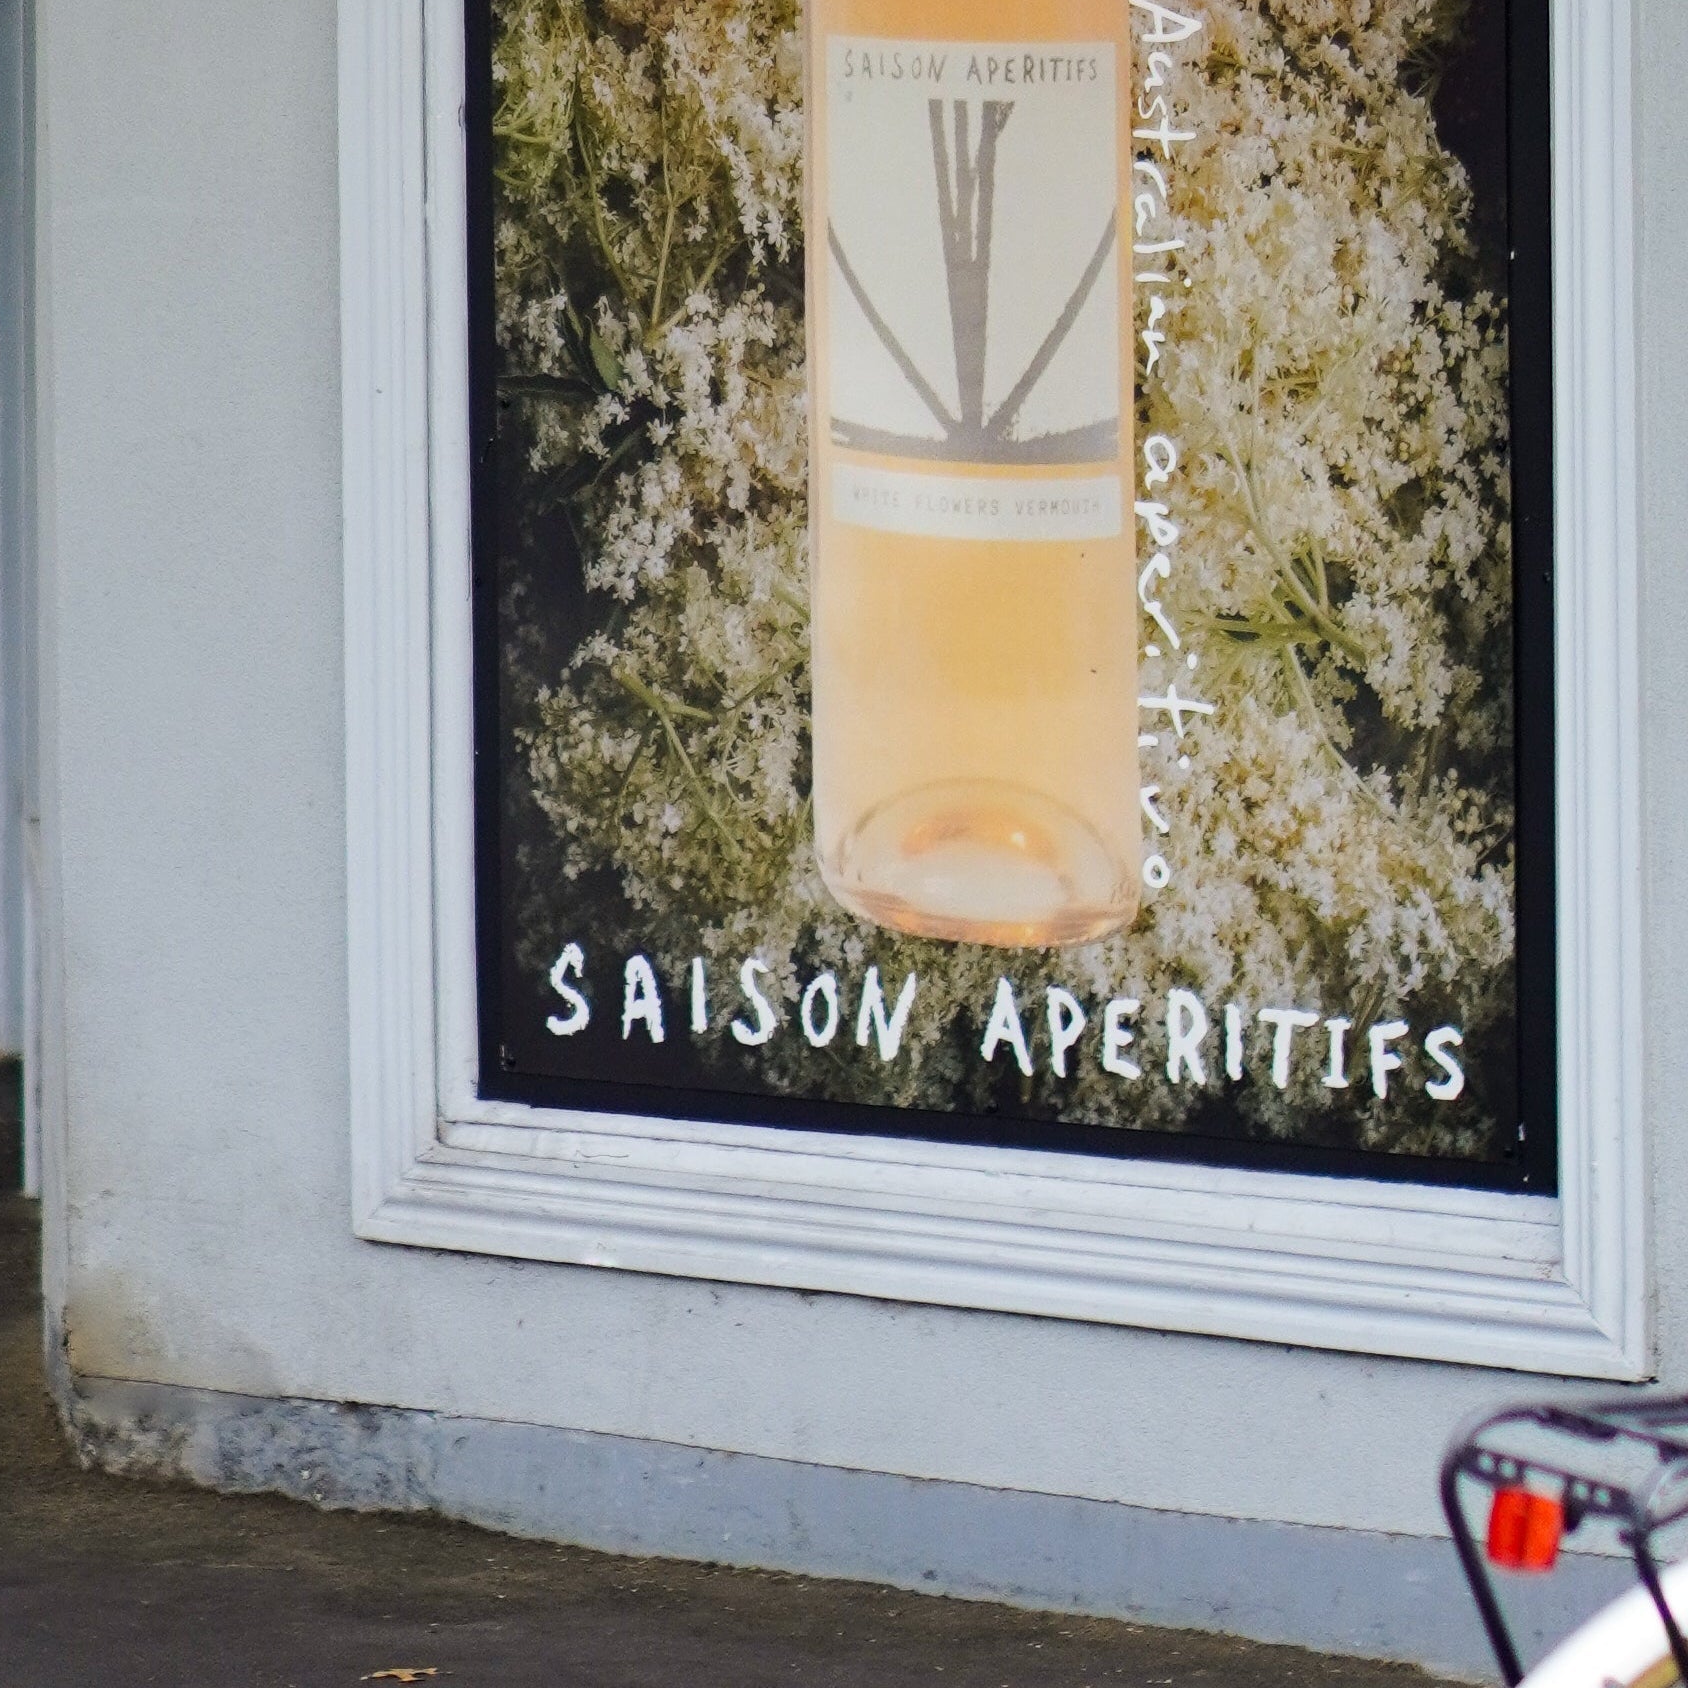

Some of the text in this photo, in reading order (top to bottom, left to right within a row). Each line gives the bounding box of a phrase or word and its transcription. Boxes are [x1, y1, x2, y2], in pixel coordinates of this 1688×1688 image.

[844, 48, 1098, 85] SAISON APERITIFS
[914, 493, 1000, 517] FLOWERS
[1134, 434, 1215, 890] aperitivo
[544, 941, 1466, 1102] SAISON APERITIFS
